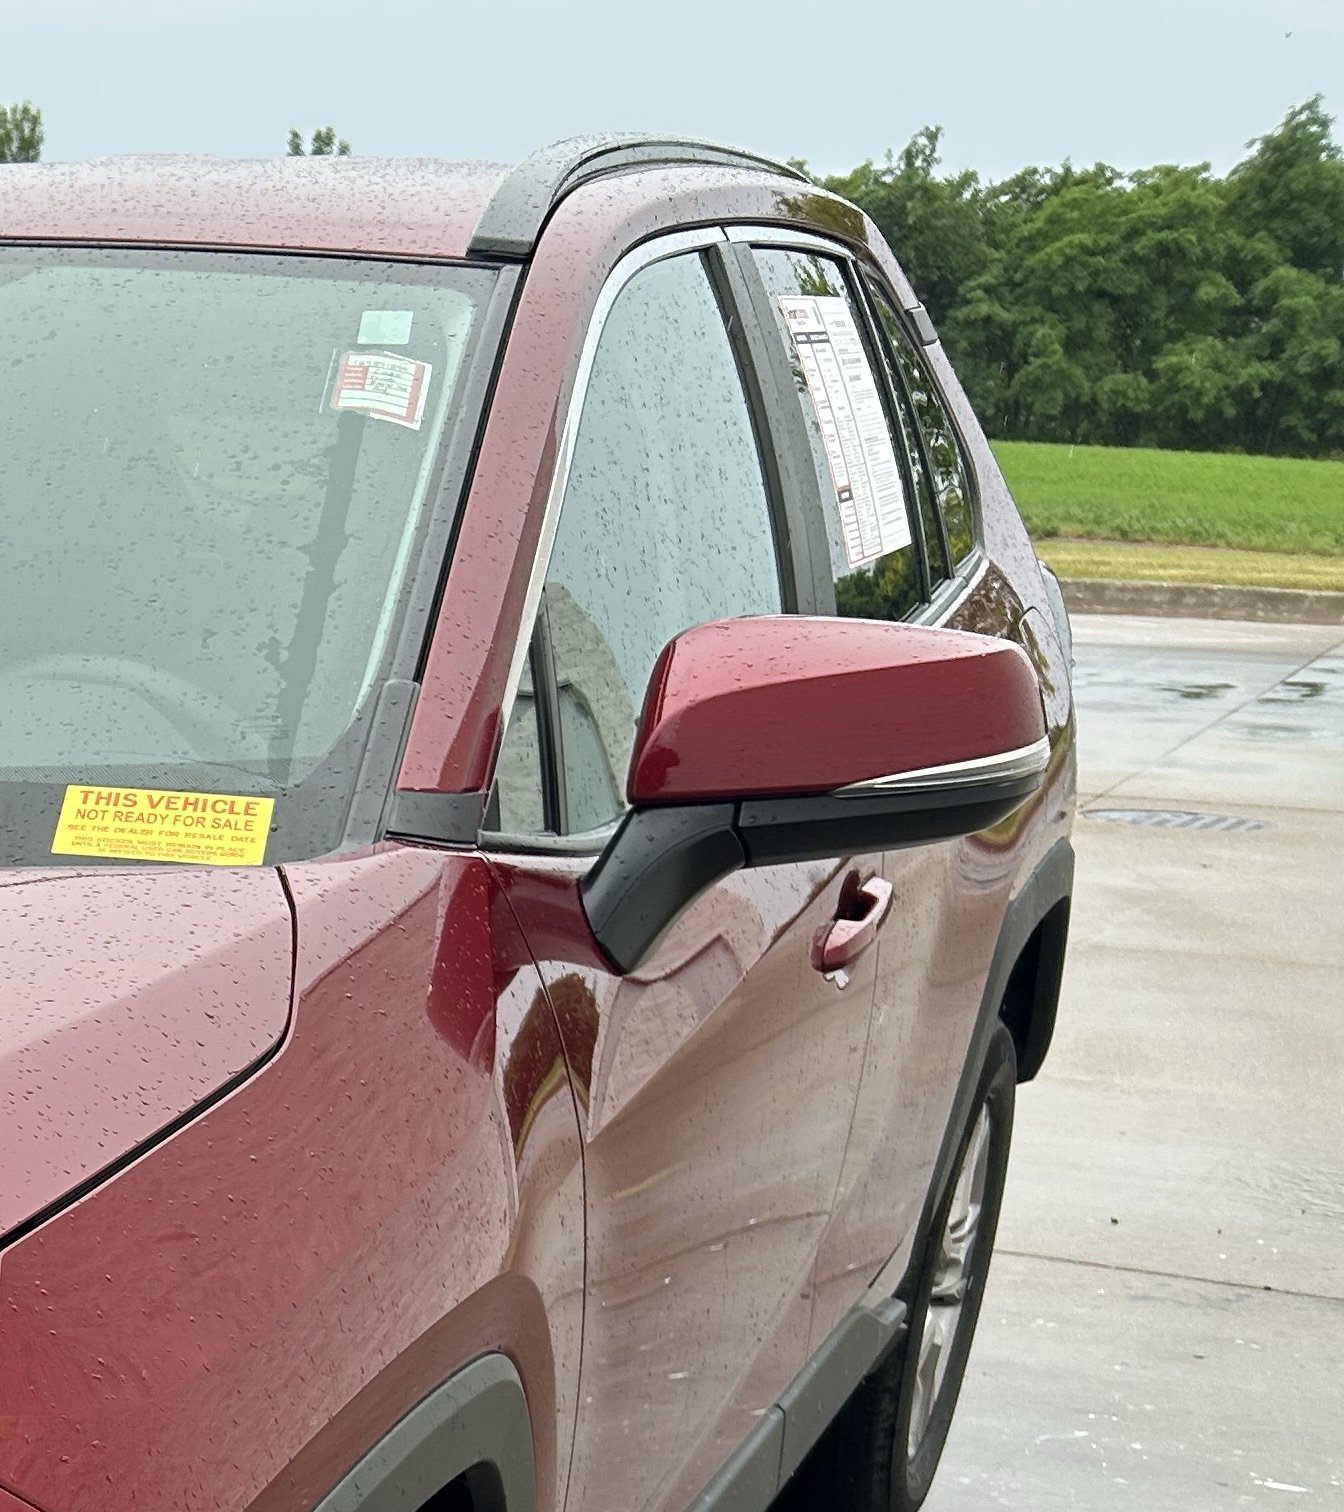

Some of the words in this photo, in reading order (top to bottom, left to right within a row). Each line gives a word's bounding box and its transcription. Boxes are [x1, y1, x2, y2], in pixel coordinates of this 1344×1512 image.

[80, 790, 138, 808] THIS
[147, 794, 260, 817] VEHICLE
[75, 808, 109, 821] NOT
[113, 810, 169, 825] READY
[173, 814, 206, 828] FOR
[211, 817, 254, 831] SALE
[92, 825, 109, 833] THE
[114, 827, 154, 836] DEALER
[184, 832, 225, 841] RESALE
[231, 835, 256, 843] DATE
